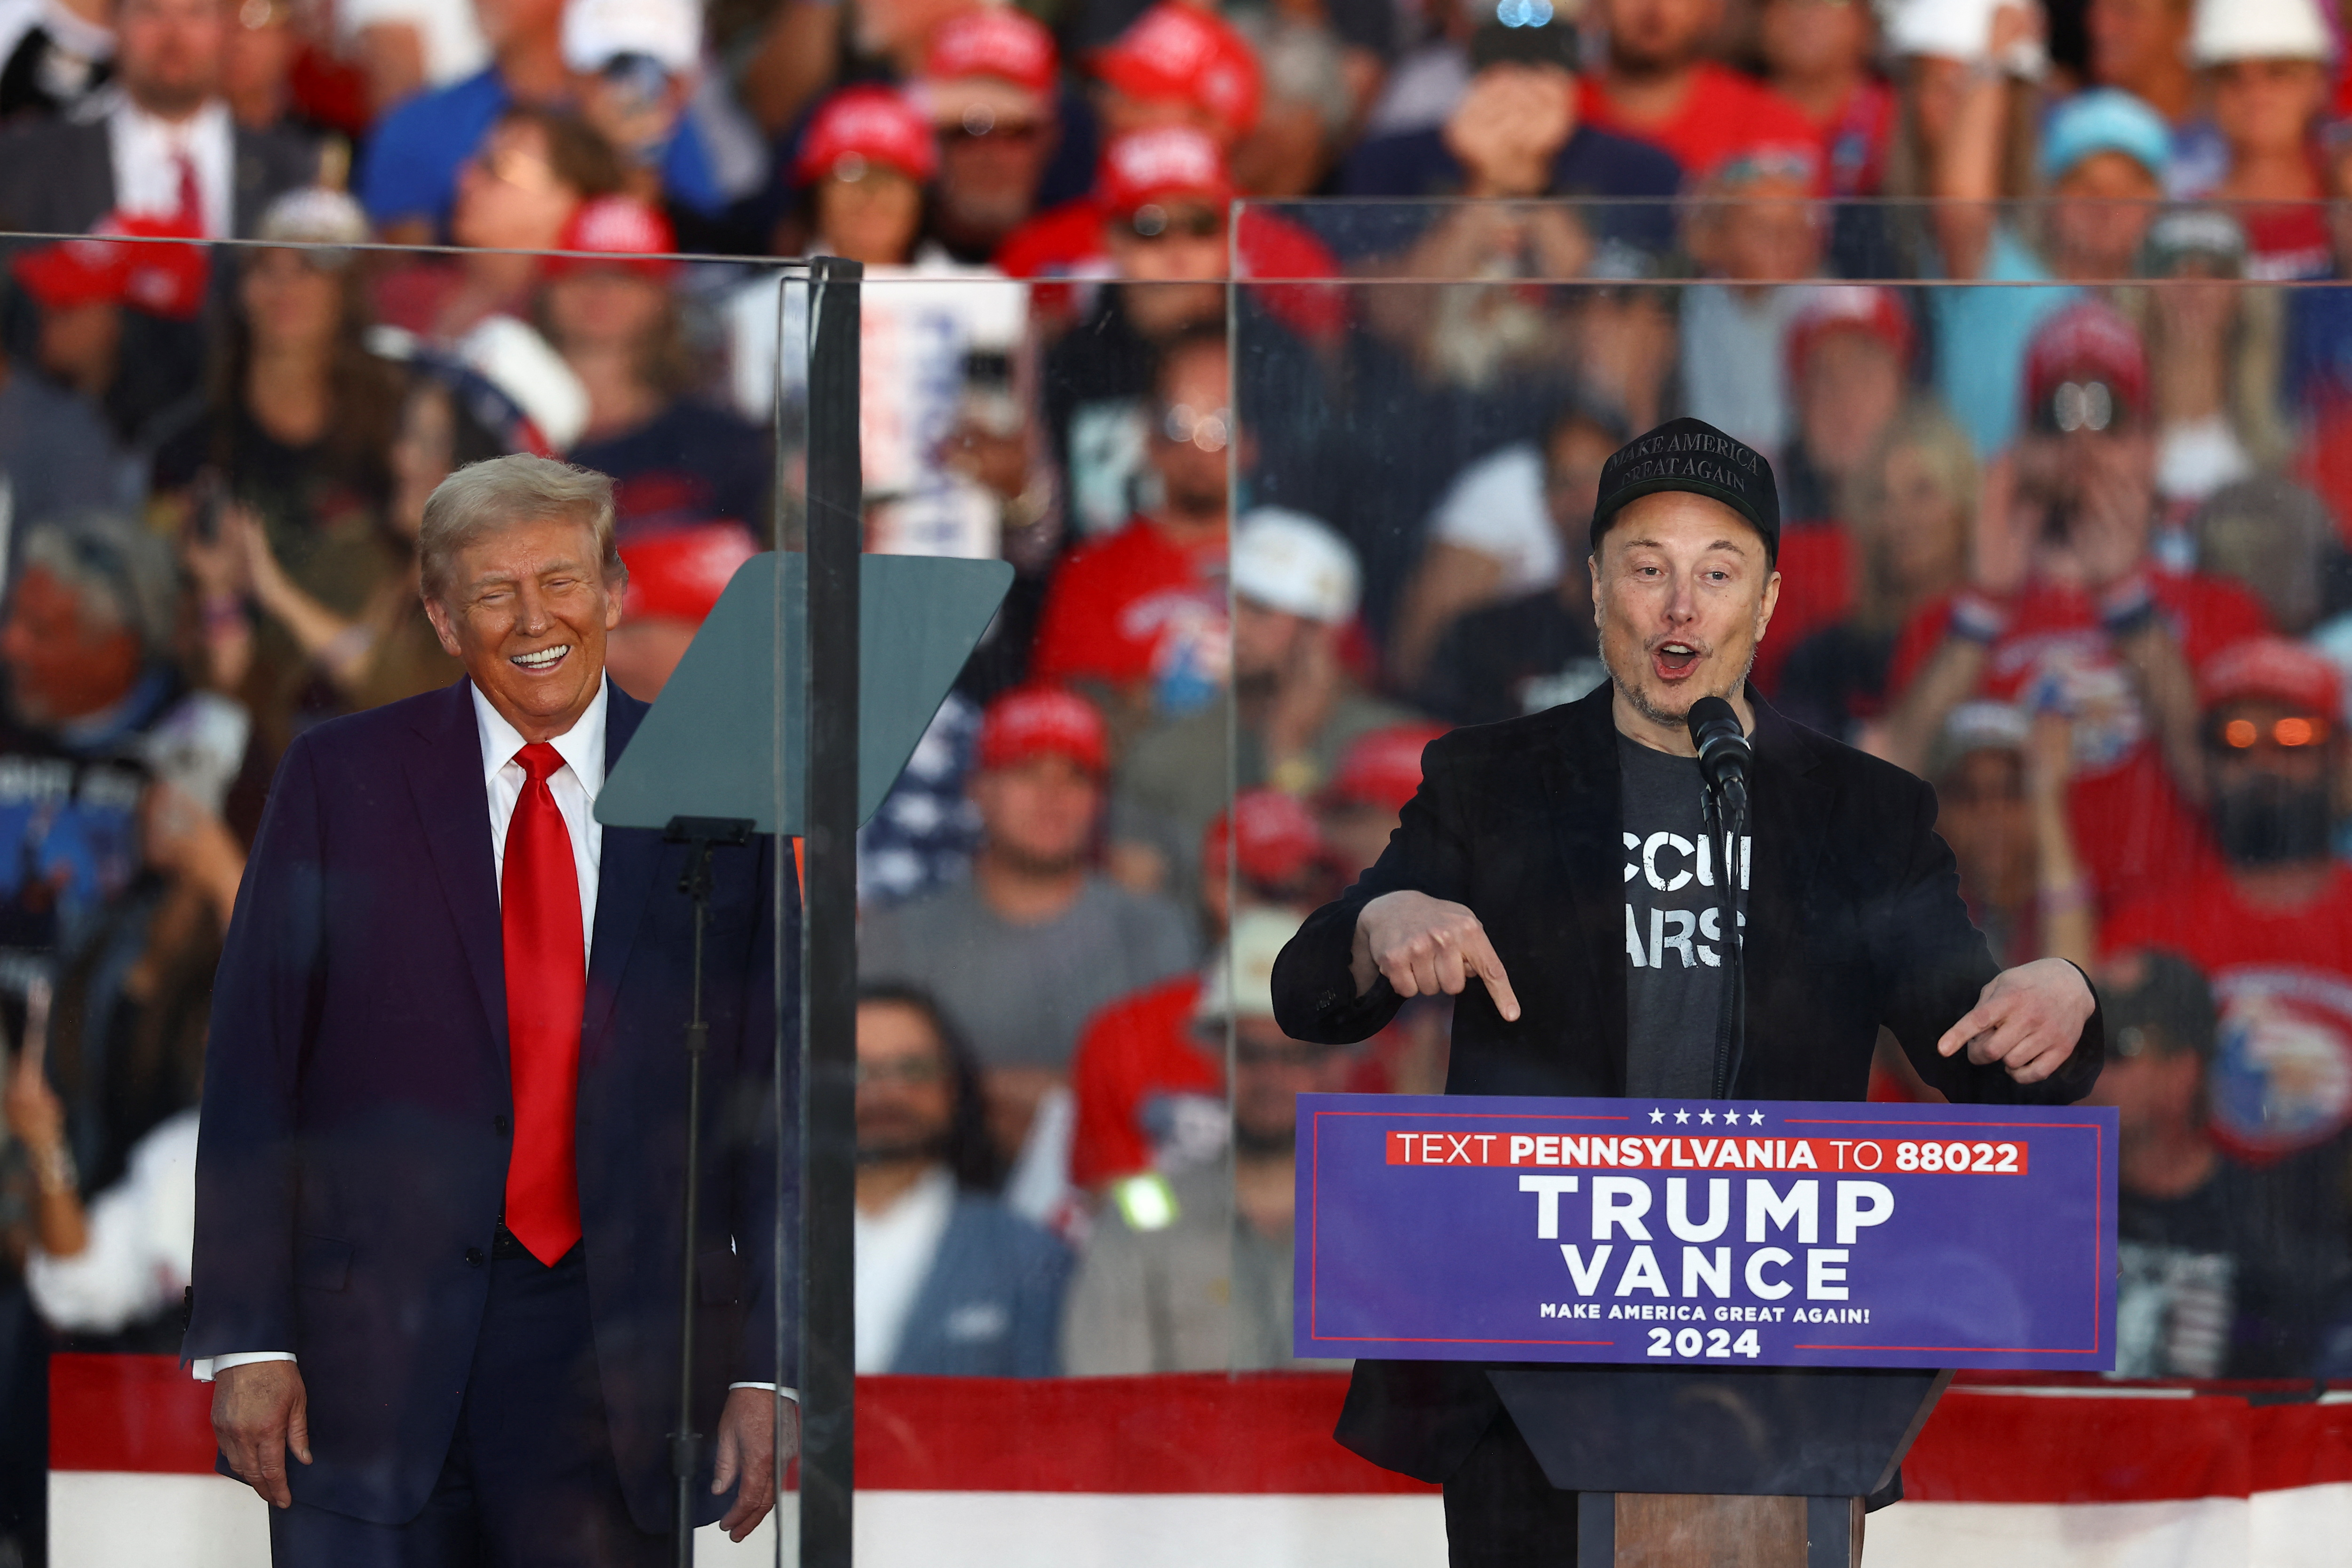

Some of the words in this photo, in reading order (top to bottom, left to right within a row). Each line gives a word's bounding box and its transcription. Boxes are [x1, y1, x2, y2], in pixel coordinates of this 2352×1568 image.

[1609, 435, 1664, 472] MAKE
[1667, 433, 1759, 476] AMERICA
[1621, 457, 1680, 486] GREAT
[1682, 458, 1745, 493] AGAIN
[1396, 1133, 1497, 1163] TEXT
[1510, 1135, 1818, 1169] PENNSYLVANIA
[1829, 1141, 1883, 1170] TO
[1896, 1142, 2018, 1172] 88022
[1518, 1175, 1894, 1244] TRUMP
[1560, 1244, 1849, 1300] VANCE
[1540, 1303, 1601, 1319] MAKE
[1608, 1305, 1707, 1321] AMERICA
[1714, 1306, 1785, 1322] GREAT
[1793, 1307, 1870, 1324] AGAIN!
[1647, 1327, 1761, 1358] 2024
